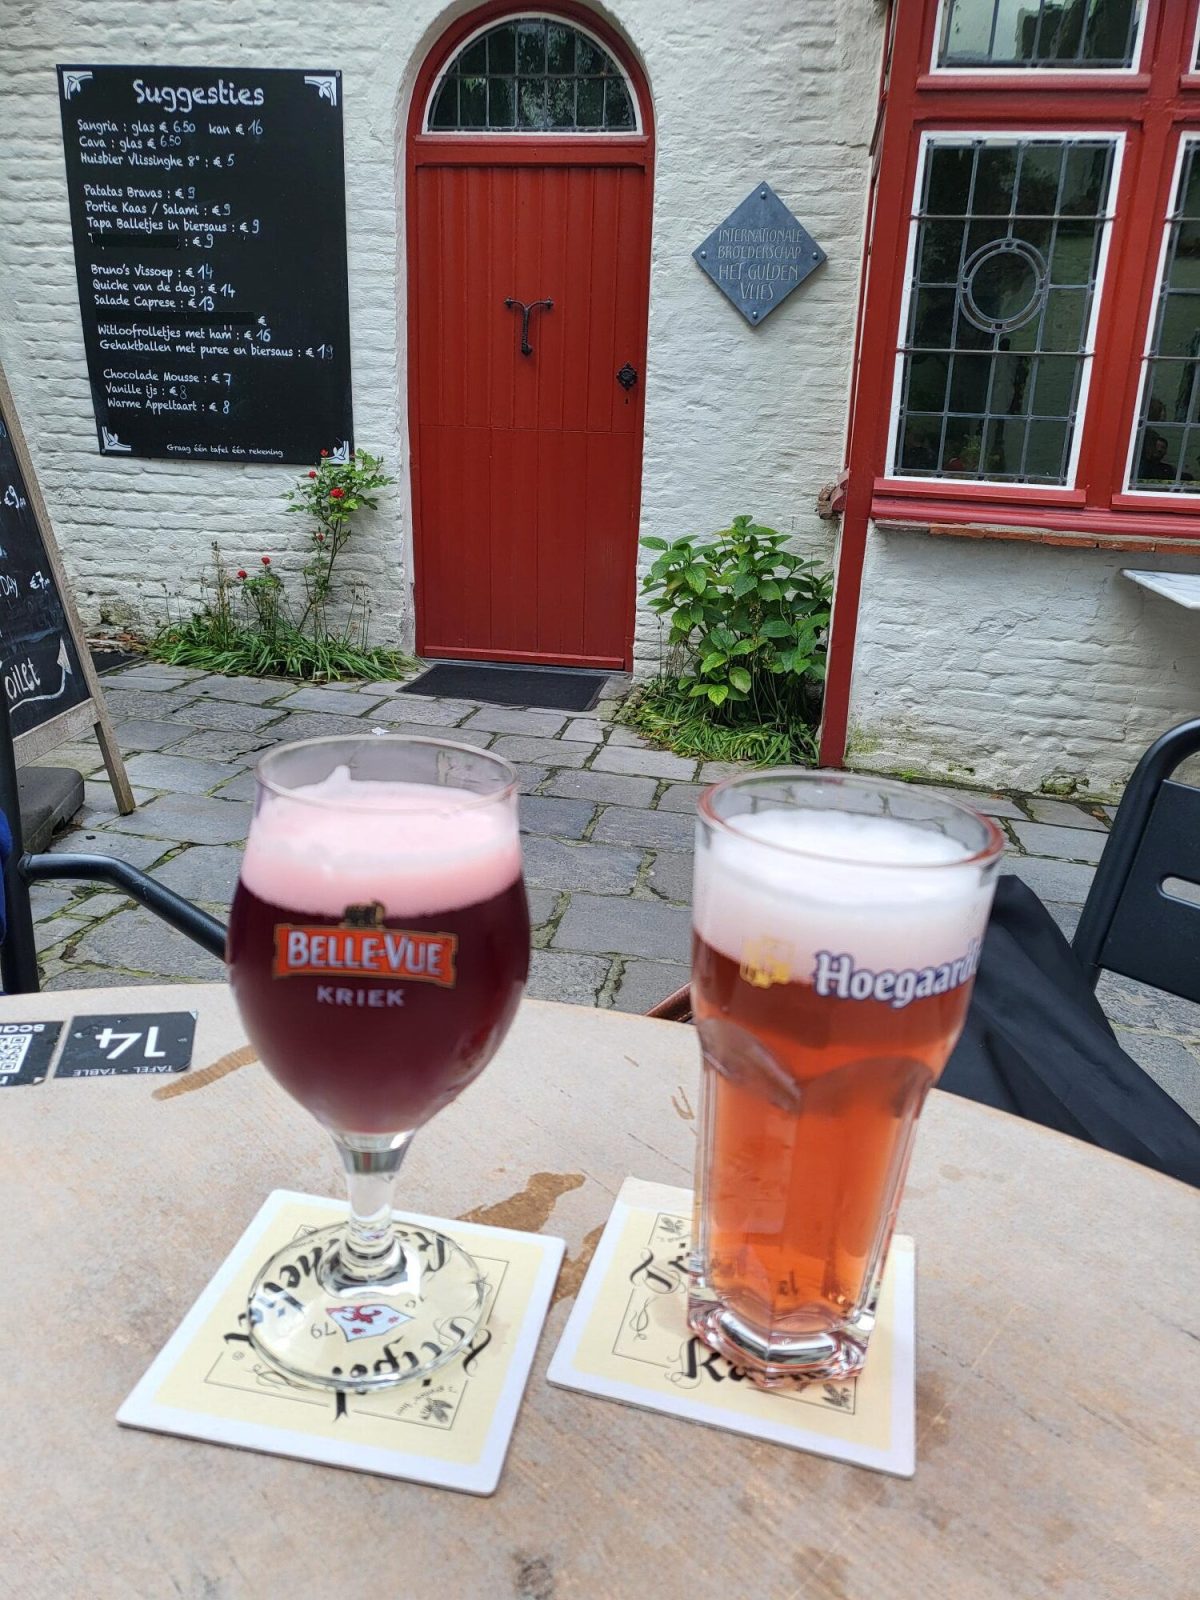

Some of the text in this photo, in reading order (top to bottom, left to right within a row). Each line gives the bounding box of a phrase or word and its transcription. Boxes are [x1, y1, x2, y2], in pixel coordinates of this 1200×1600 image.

[133, 79, 264, 113] Suggesties
[78, 119, 118, 135] Sangria
[132, 120, 154, 136] glas
[209, 123, 231, 134] kan
[248, 119, 263, 135] 16
[79, 136, 106, 147] Cava
[119, 137, 142, 152] glas
[81, 151, 123, 165] Huisbier
[128, 152, 183, 170] Vlissinghe
[227, 154, 234, 166] 5
[84, 184, 123, 197] Patatas
[127, 187, 162, 198] Bravas
[85, 200, 118, 212] Portie
[122, 202, 146, 213] Kaas
[152, 202, 158, 215] /
[163, 203, 199, 215] Salami
[86, 216, 112, 234] Tapa
[117, 217, 163, 234] Balletjes
[168, 220, 179, 230] in
[184, 218, 227, 232] biersaus
[718, 227, 802, 243] INTERNATIONALE
[718, 245, 802, 259] BROEDERSCHAP
[134, 264, 173, 283] Vissoep
[197, 264, 213, 280] 14
[719, 262, 798, 281] HET GULDEN
[93, 279, 129, 290] Quiche
[157, 280, 171, 292] de
[175, 281, 195, 297] dag
[220, 284, 235, 298] 14
[740, 282, 774, 300] VLIES
[94, 294, 130, 306] Salade
[134, 296, 176, 312] Caprese
[98, 324, 180, 341] Witloofrolletjes
[185, 328, 205, 338] met
[209, 328, 231, 339] ham
[256, 329, 271, 342] 16
[100, 339, 171, 351] Gehaktballen
[176, 342, 195, 353] met
[200, 346, 229, 359] puree
[233, 347, 247, 355] en
[251, 343, 293, 356] biersaus
[104, 369, 159, 380] Chocolade
[164, 372, 199, 382] Mousse
[223, 373, 231, 386] 7
[106, 382, 142, 394] Vanille
[146, 386, 157, 398] ijs
[108, 398, 141, 408] Warme
[146, 400, 197, 415] Appeltaart
[167, 444, 191, 454] Graag
[211, 445, 228, 454] tafel
[249, 448, 283, 457] rekening
[316, 985, 405, 1008] KRIEK
[0, 1024, 46, 1033] sca
[95, 1026, 166, 1060] 14
[73, 1068, 118, 1077] TABLE
[133, 1065, 172, 1073] TAFEL
